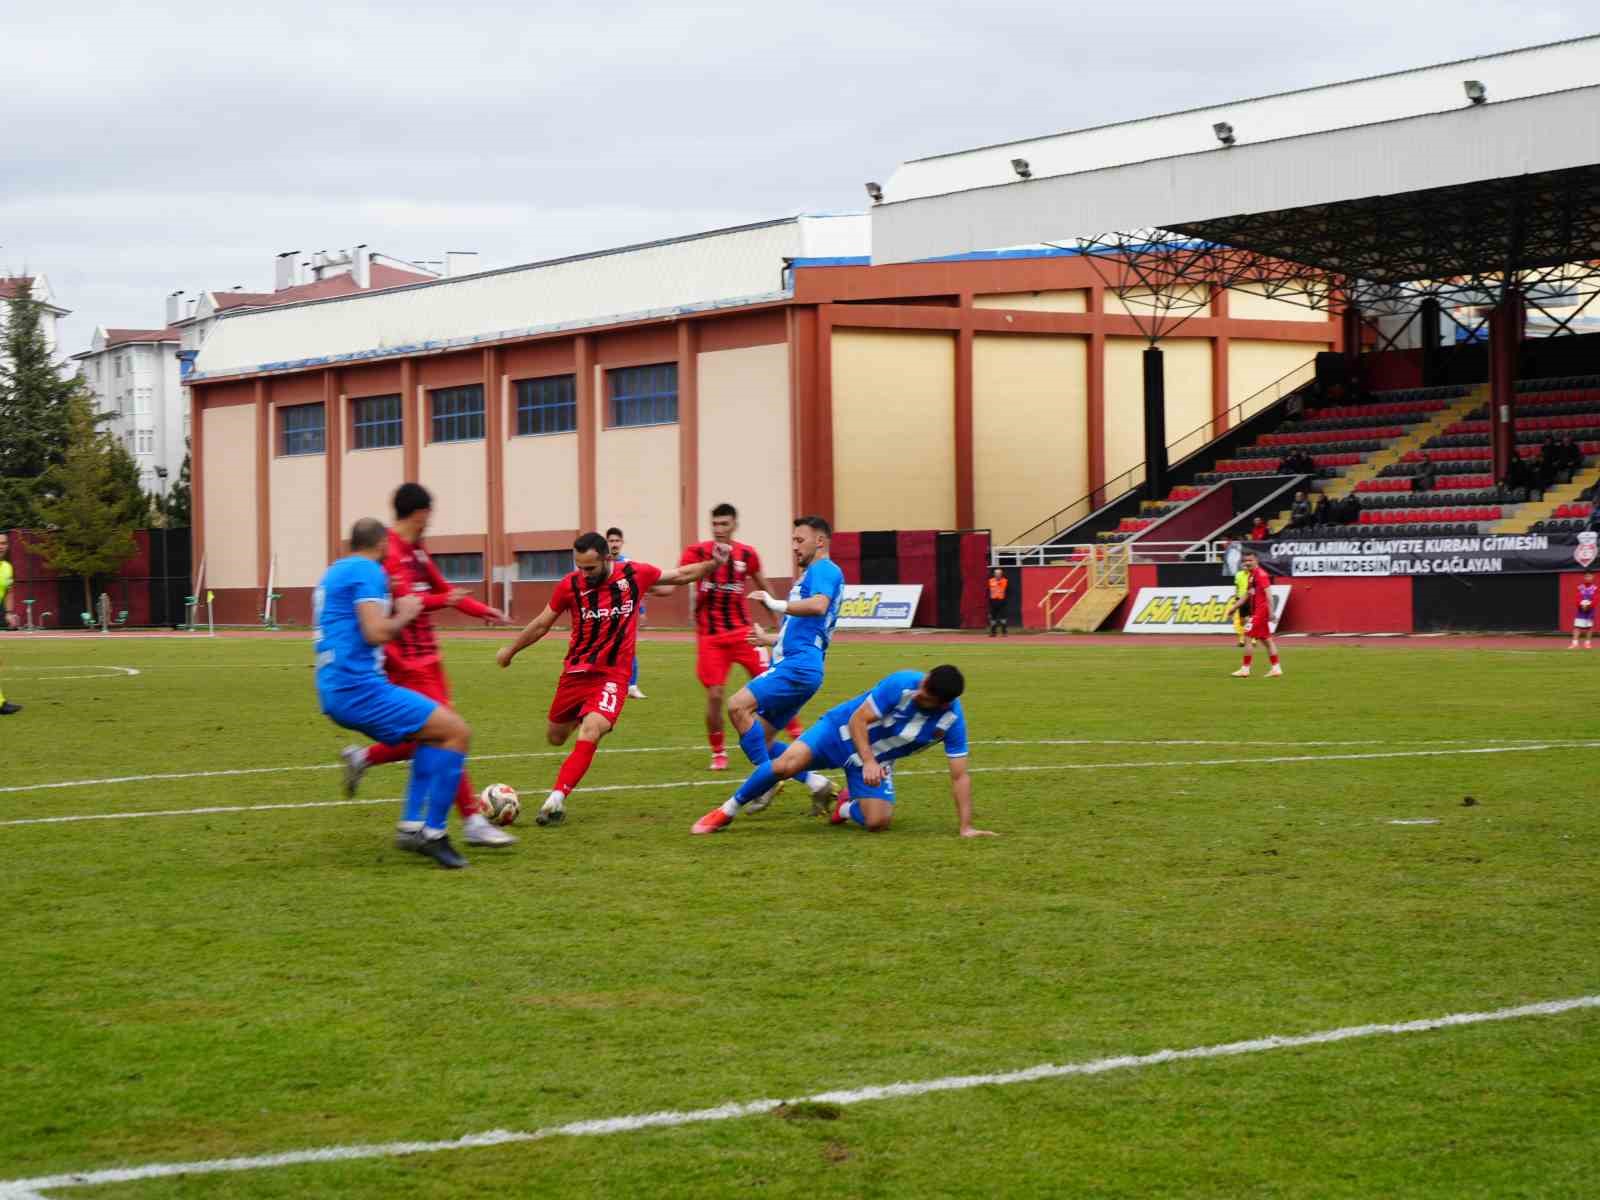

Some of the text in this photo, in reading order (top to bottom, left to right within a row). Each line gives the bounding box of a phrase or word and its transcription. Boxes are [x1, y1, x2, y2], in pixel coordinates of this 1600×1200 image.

[1425, 537, 1479, 553] KURBAN
[1482, 533, 1549, 552] GİTMESİN
[1391, 559, 1431, 573] ATLAS
